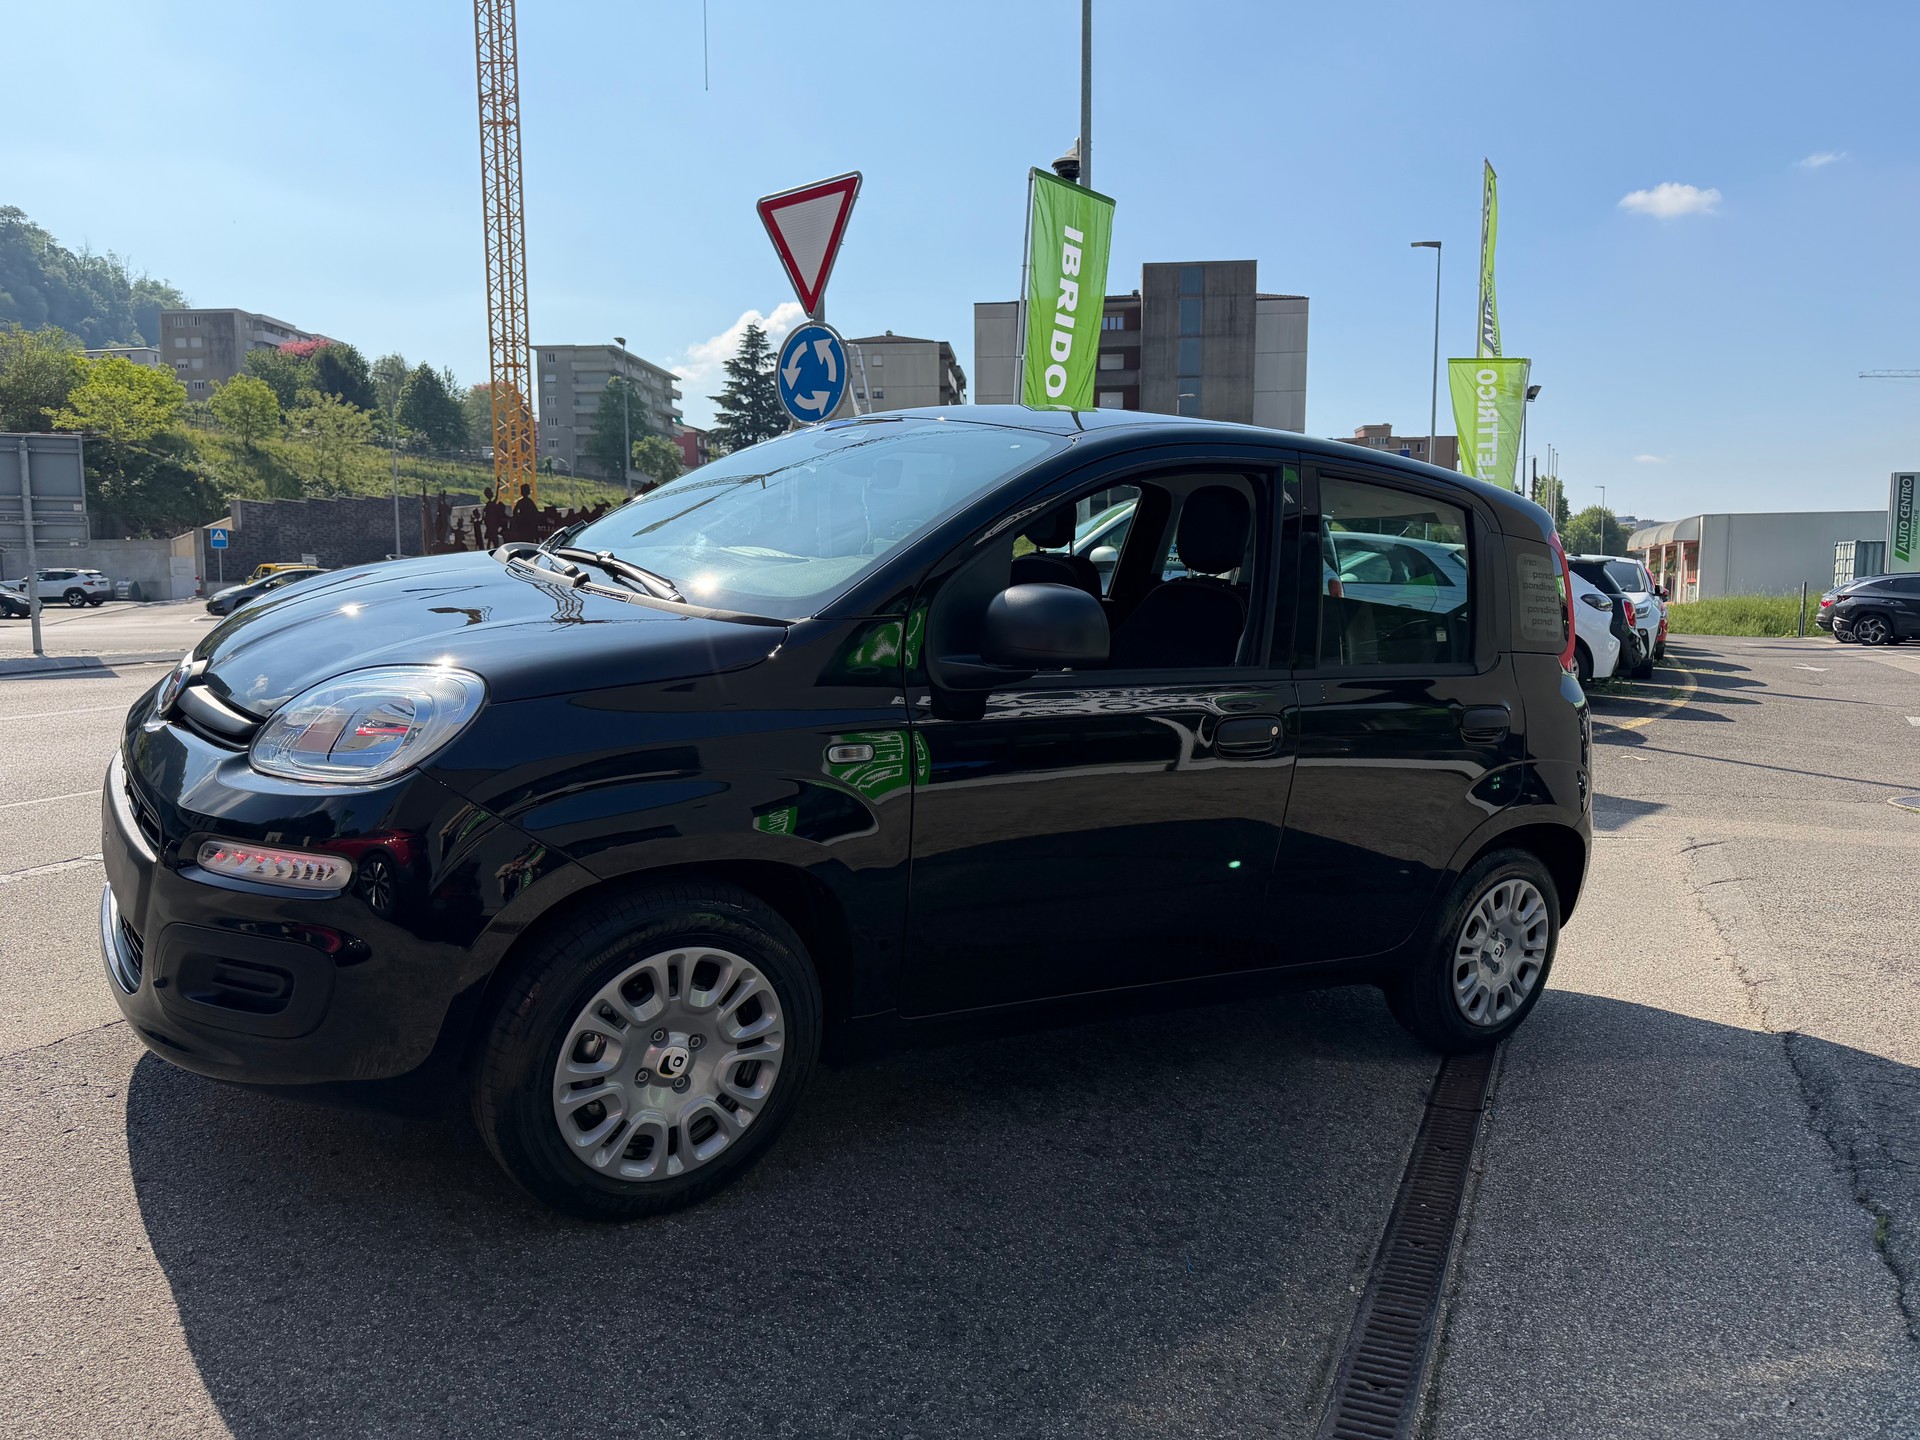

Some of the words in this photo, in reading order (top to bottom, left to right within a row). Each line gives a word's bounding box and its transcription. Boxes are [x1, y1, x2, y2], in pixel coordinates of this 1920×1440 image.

[1044, 225, 1084, 399] IBRIDO
[1900, 478, 1912, 518] CENTRO
[1898, 521, 1910, 549] AUTO
[1911, 509, 1919, 549] MULTIMARCHE
